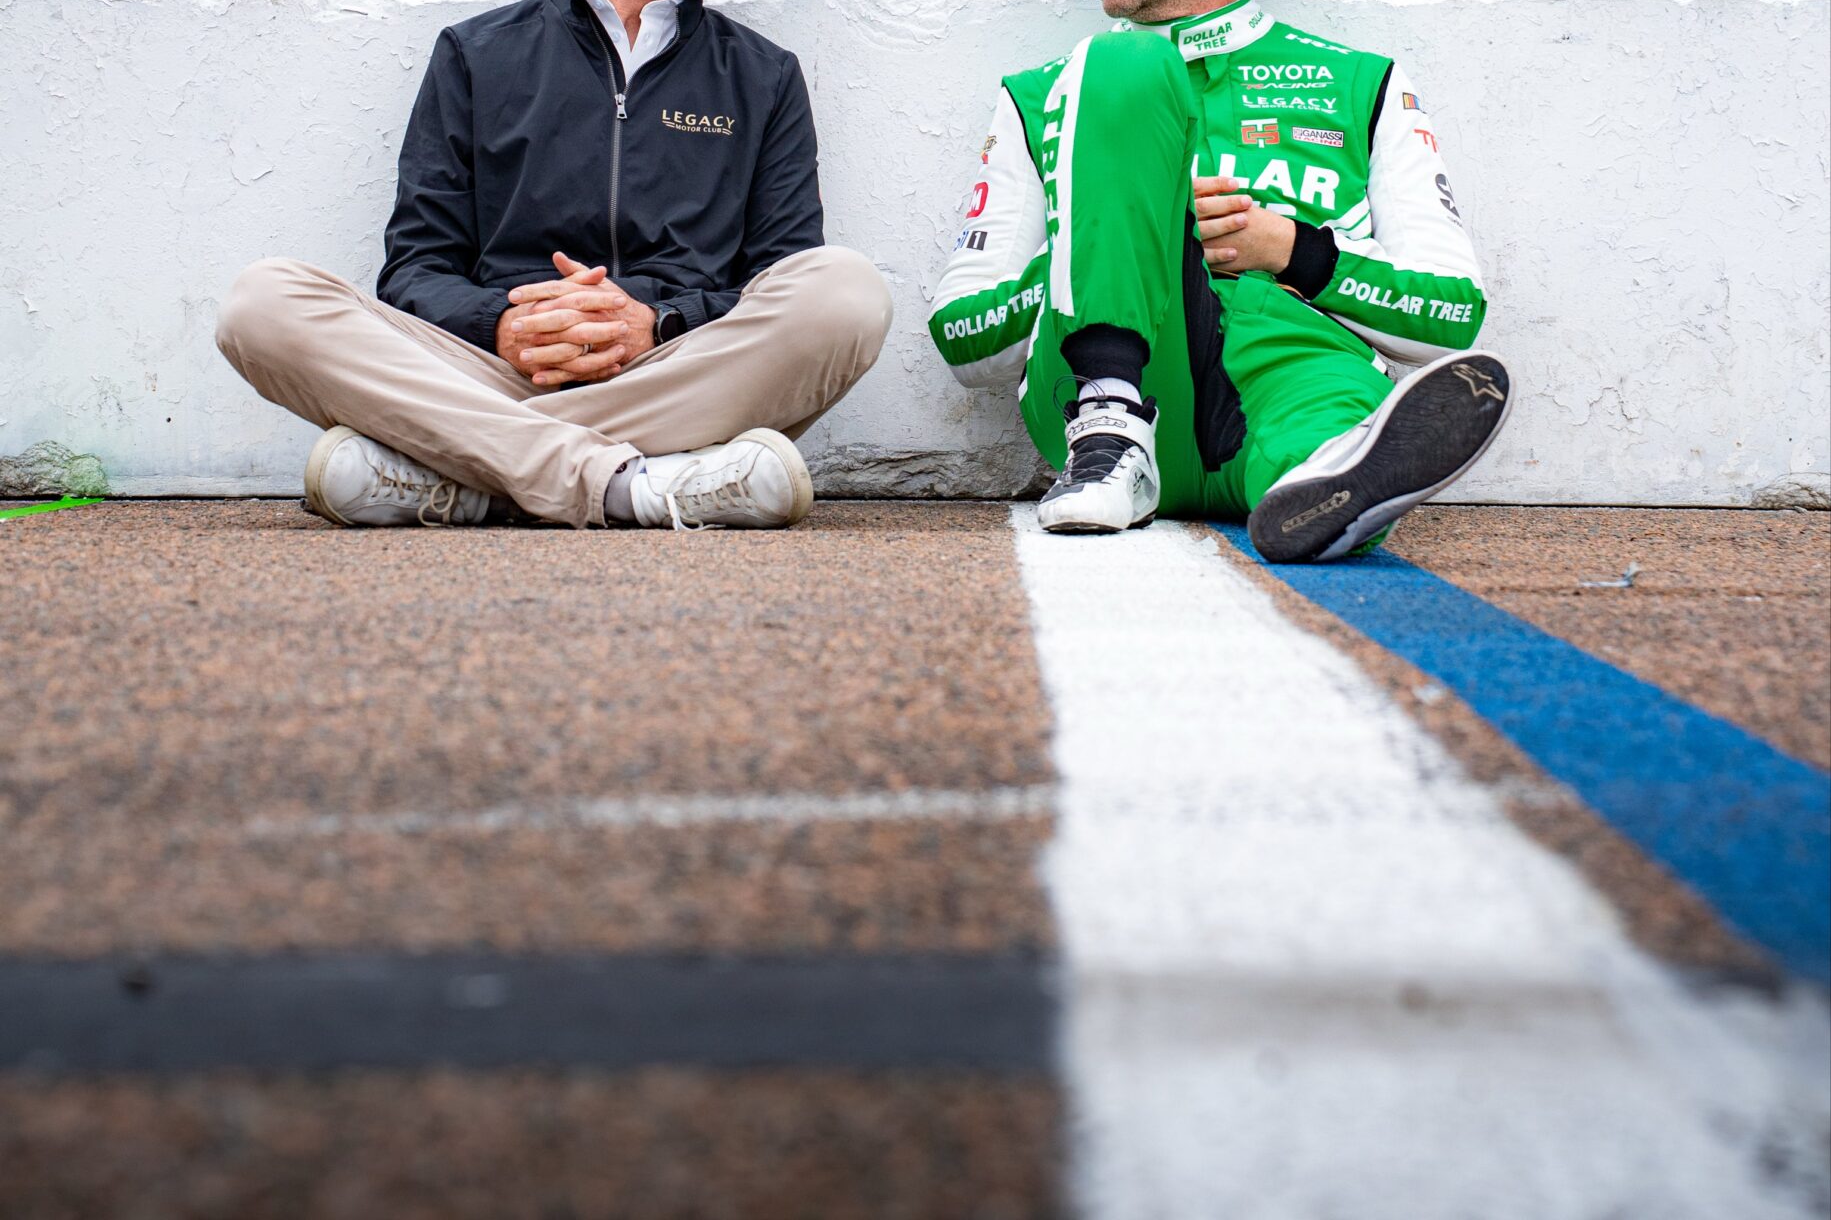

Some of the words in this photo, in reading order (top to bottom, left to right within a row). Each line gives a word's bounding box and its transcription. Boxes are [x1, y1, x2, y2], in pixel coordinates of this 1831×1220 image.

[1248, 11, 1265, 29] DOLLA
[1182, 22, 1233, 46] DOLLAR
[1195, 36, 1228, 52] TREE
[1237, 64, 1334, 81] TOYOTA
[1242, 94, 1337, 110] LEGACY
[662, 109, 736, 130] LEGACY
[675, 123, 701, 133] MOTOR
[1302, 129, 1343, 142] GANASSI
[1008, 282, 1045, 314] TRE
[1337, 277, 1425, 316] DOLLAR
[1429, 299, 1473, 323] TREE
[943, 305, 1008, 341] DOLLAR
